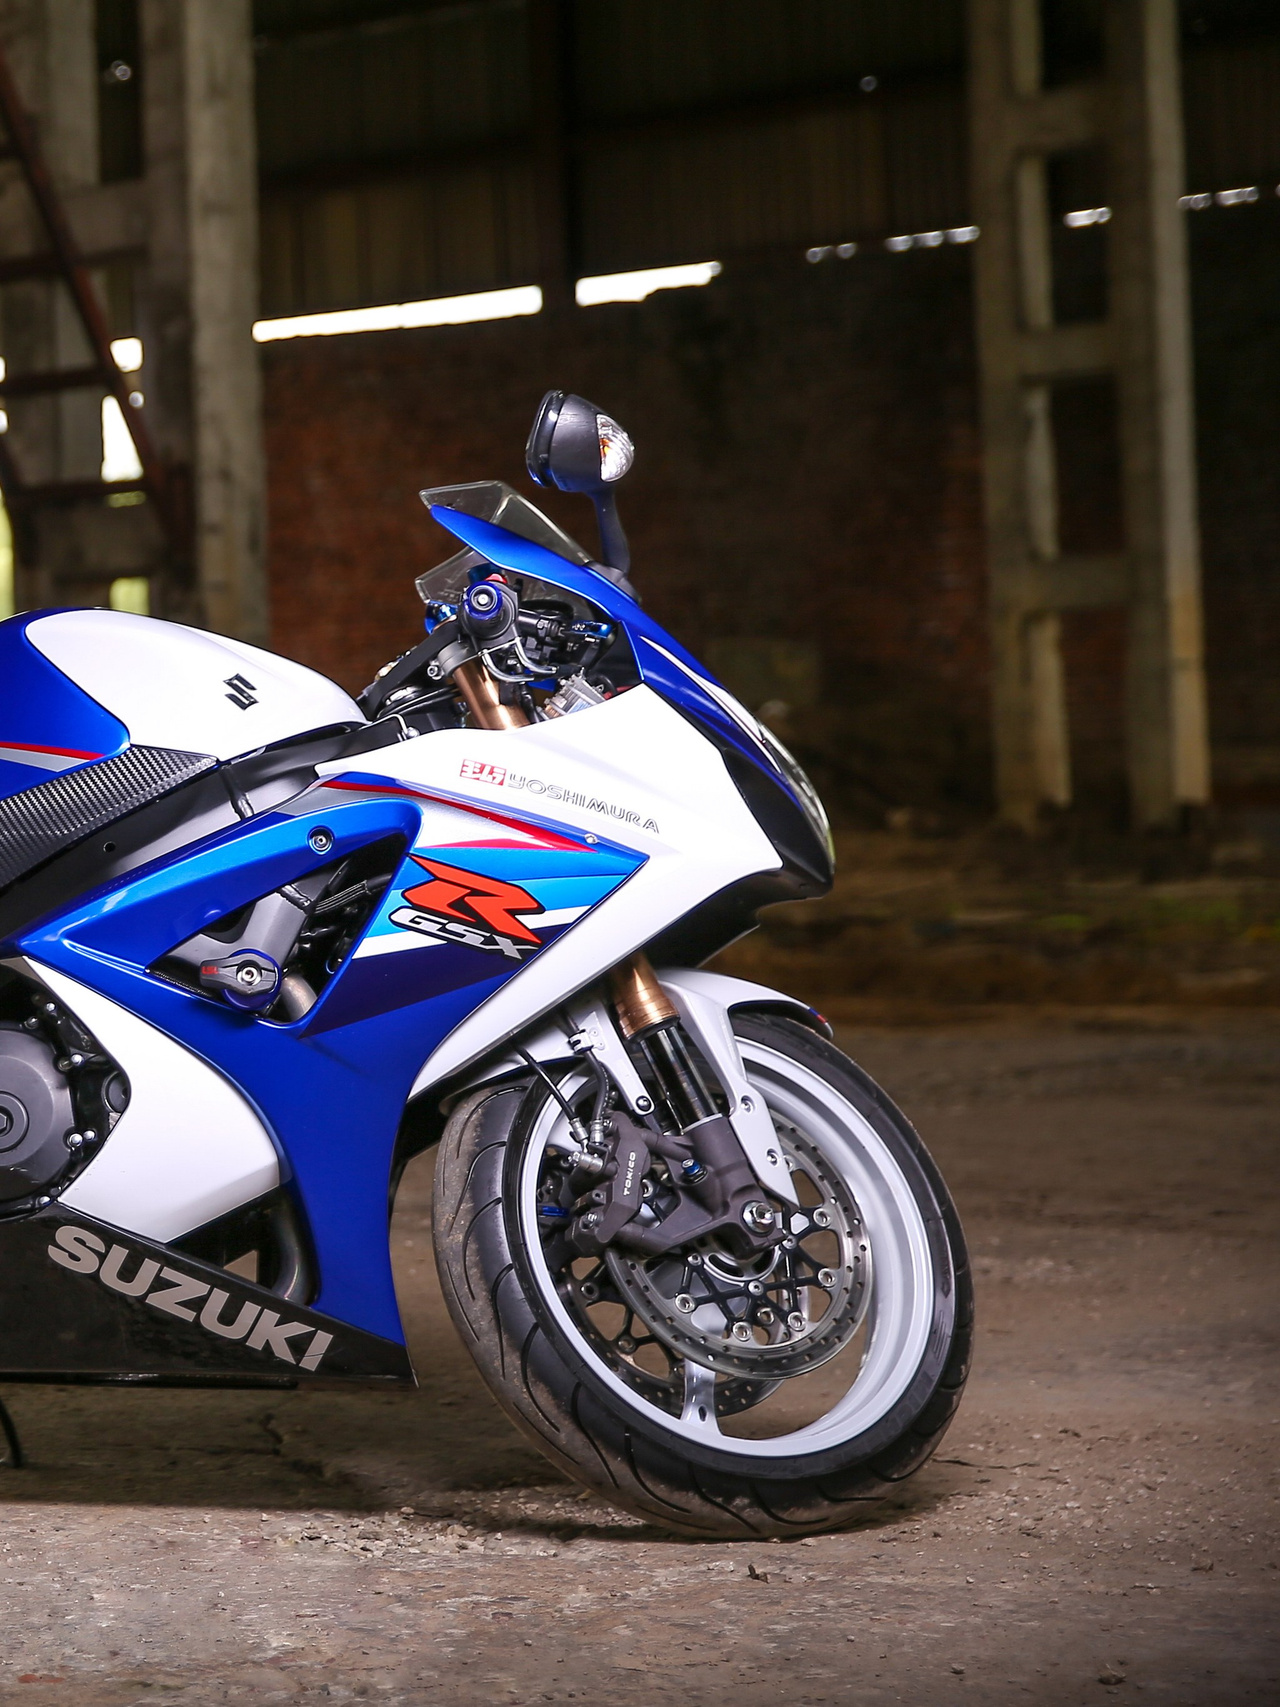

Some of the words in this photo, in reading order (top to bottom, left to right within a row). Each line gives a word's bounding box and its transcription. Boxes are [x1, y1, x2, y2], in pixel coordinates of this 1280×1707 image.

[508, 773, 660, 834] YOSHIMURA
[403, 854, 542, 944] R
[390, 907, 539, 960] GSX
[623, 1151, 636, 1196] TOKICO
[47, 1225, 334, 1372] SUZUKI
